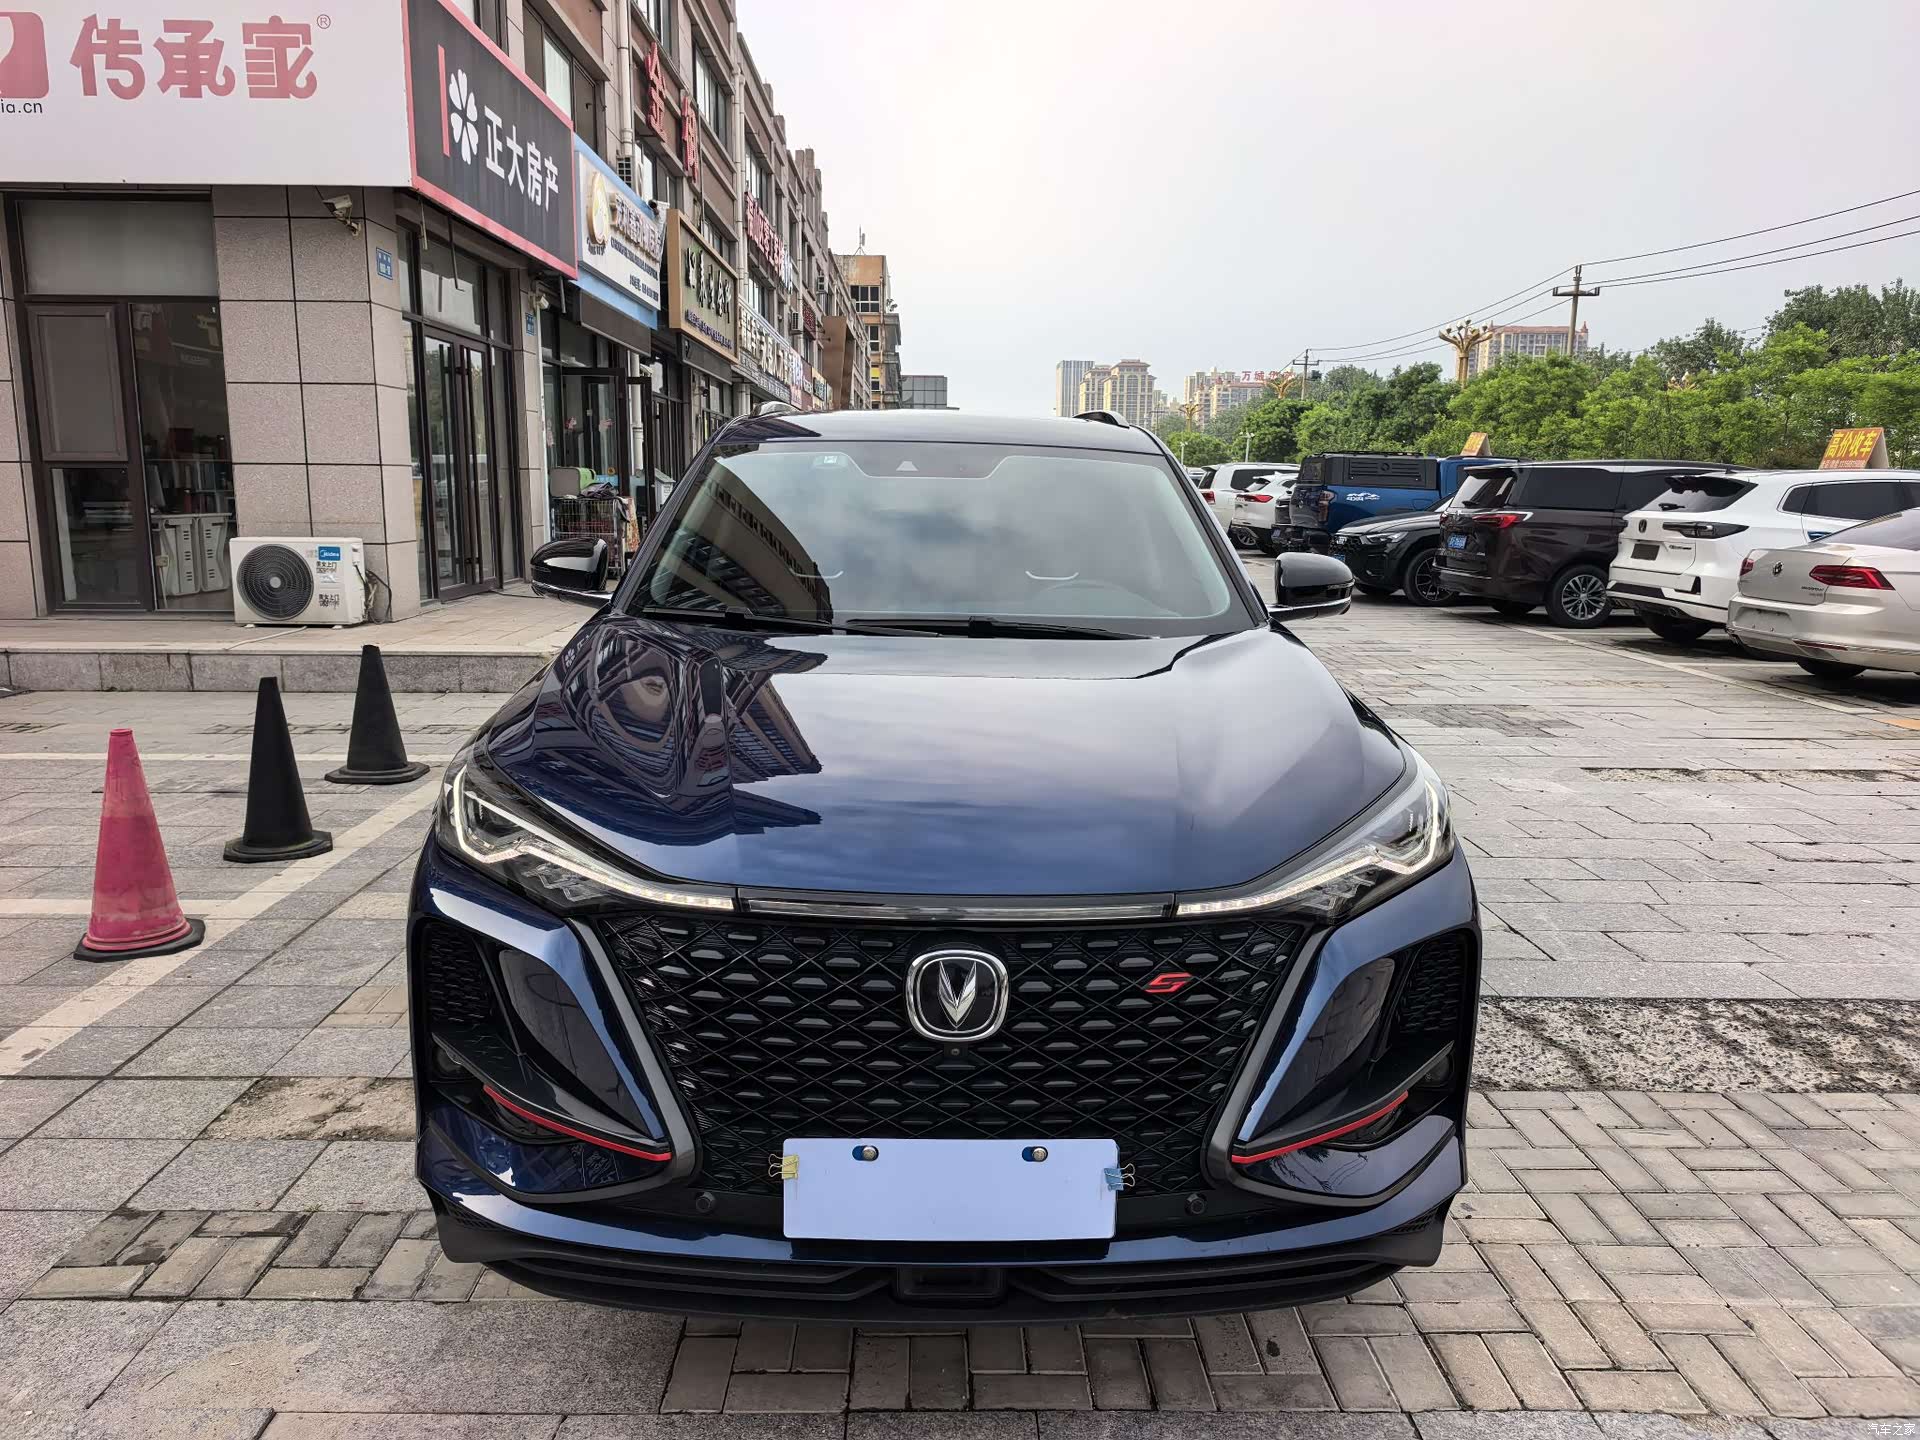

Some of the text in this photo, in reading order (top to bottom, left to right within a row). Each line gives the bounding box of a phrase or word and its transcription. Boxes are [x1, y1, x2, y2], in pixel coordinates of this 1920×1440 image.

[70, 13, 318, 100] 传承家
[484, 105, 560, 212] 正大房产
[1824, 431, 1878, 458] 高价收车
